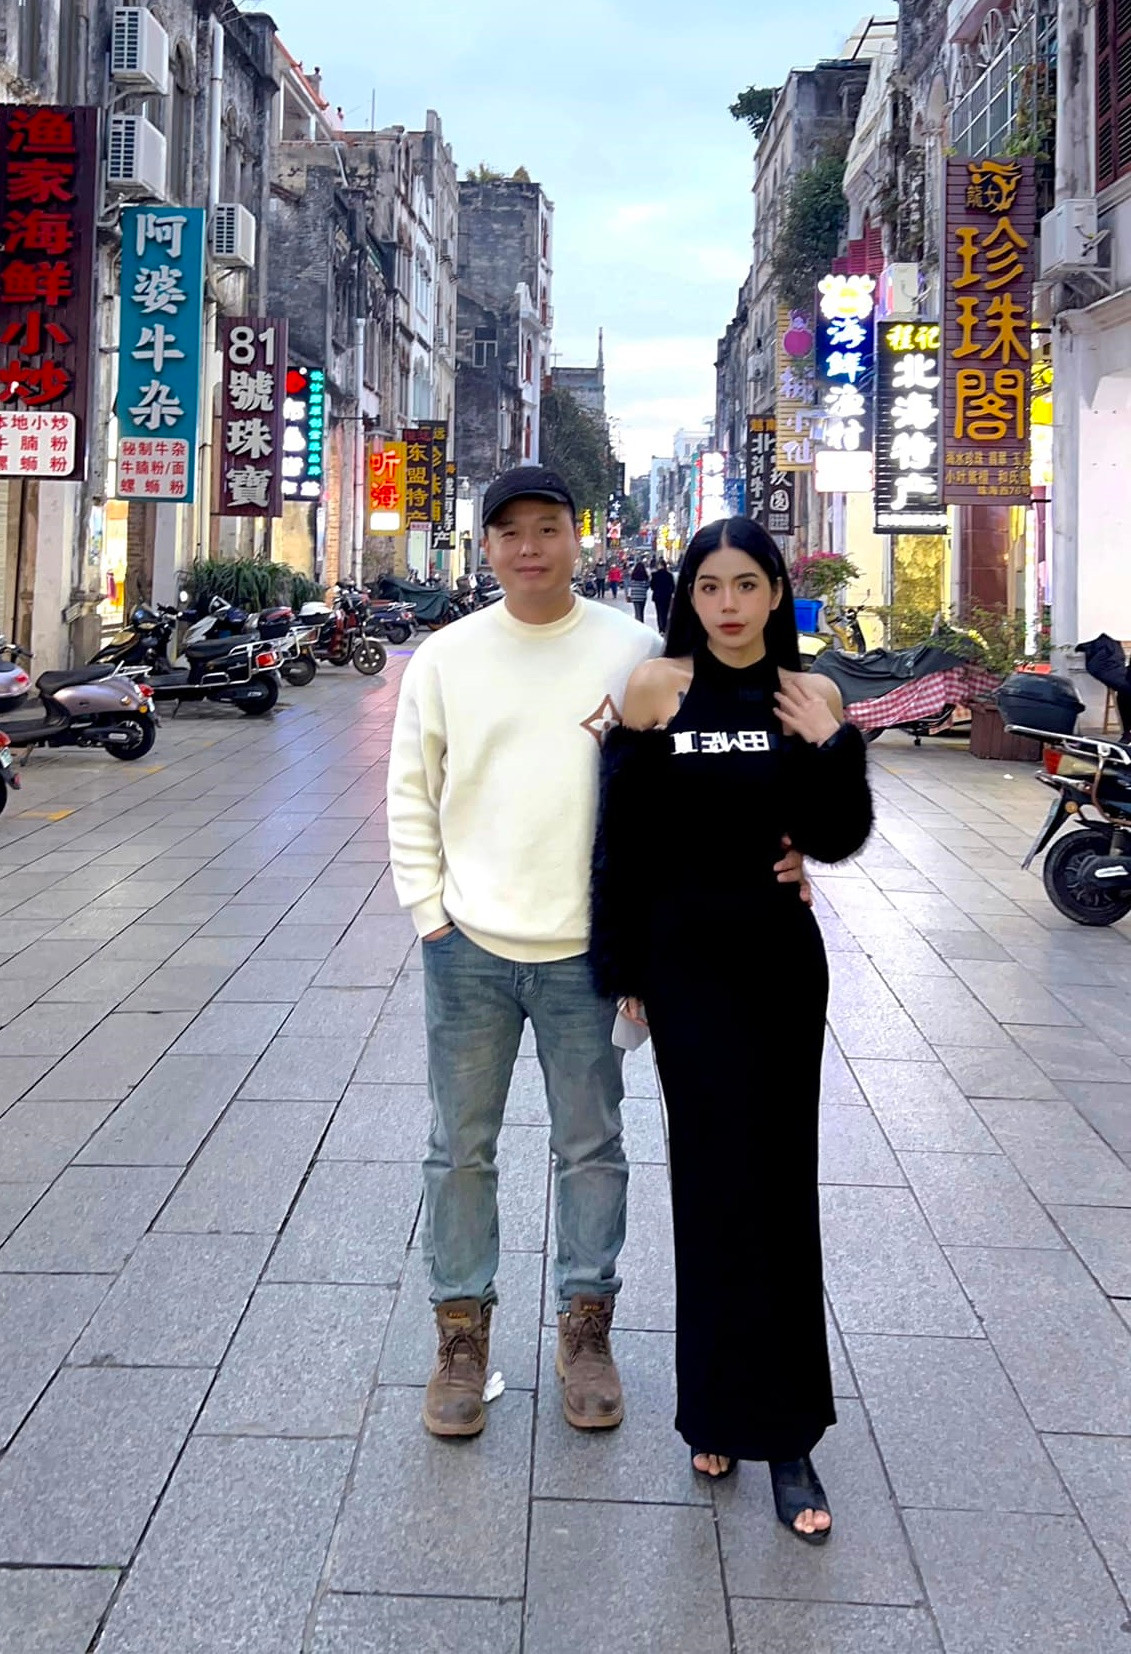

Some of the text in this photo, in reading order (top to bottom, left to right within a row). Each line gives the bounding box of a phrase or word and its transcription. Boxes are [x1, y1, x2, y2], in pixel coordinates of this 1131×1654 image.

[0, 108, 75, 406] 渔家海鲜小炒
[128, 212, 187, 431] 阿婆牛杂
[952, 216, 1029, 441] 珍珠閣
[122, 441, 186, 456] 秘制牛杂
[226, 326, 276, 507] 81號珠寶
[370, 450, 401, 510] 听海
